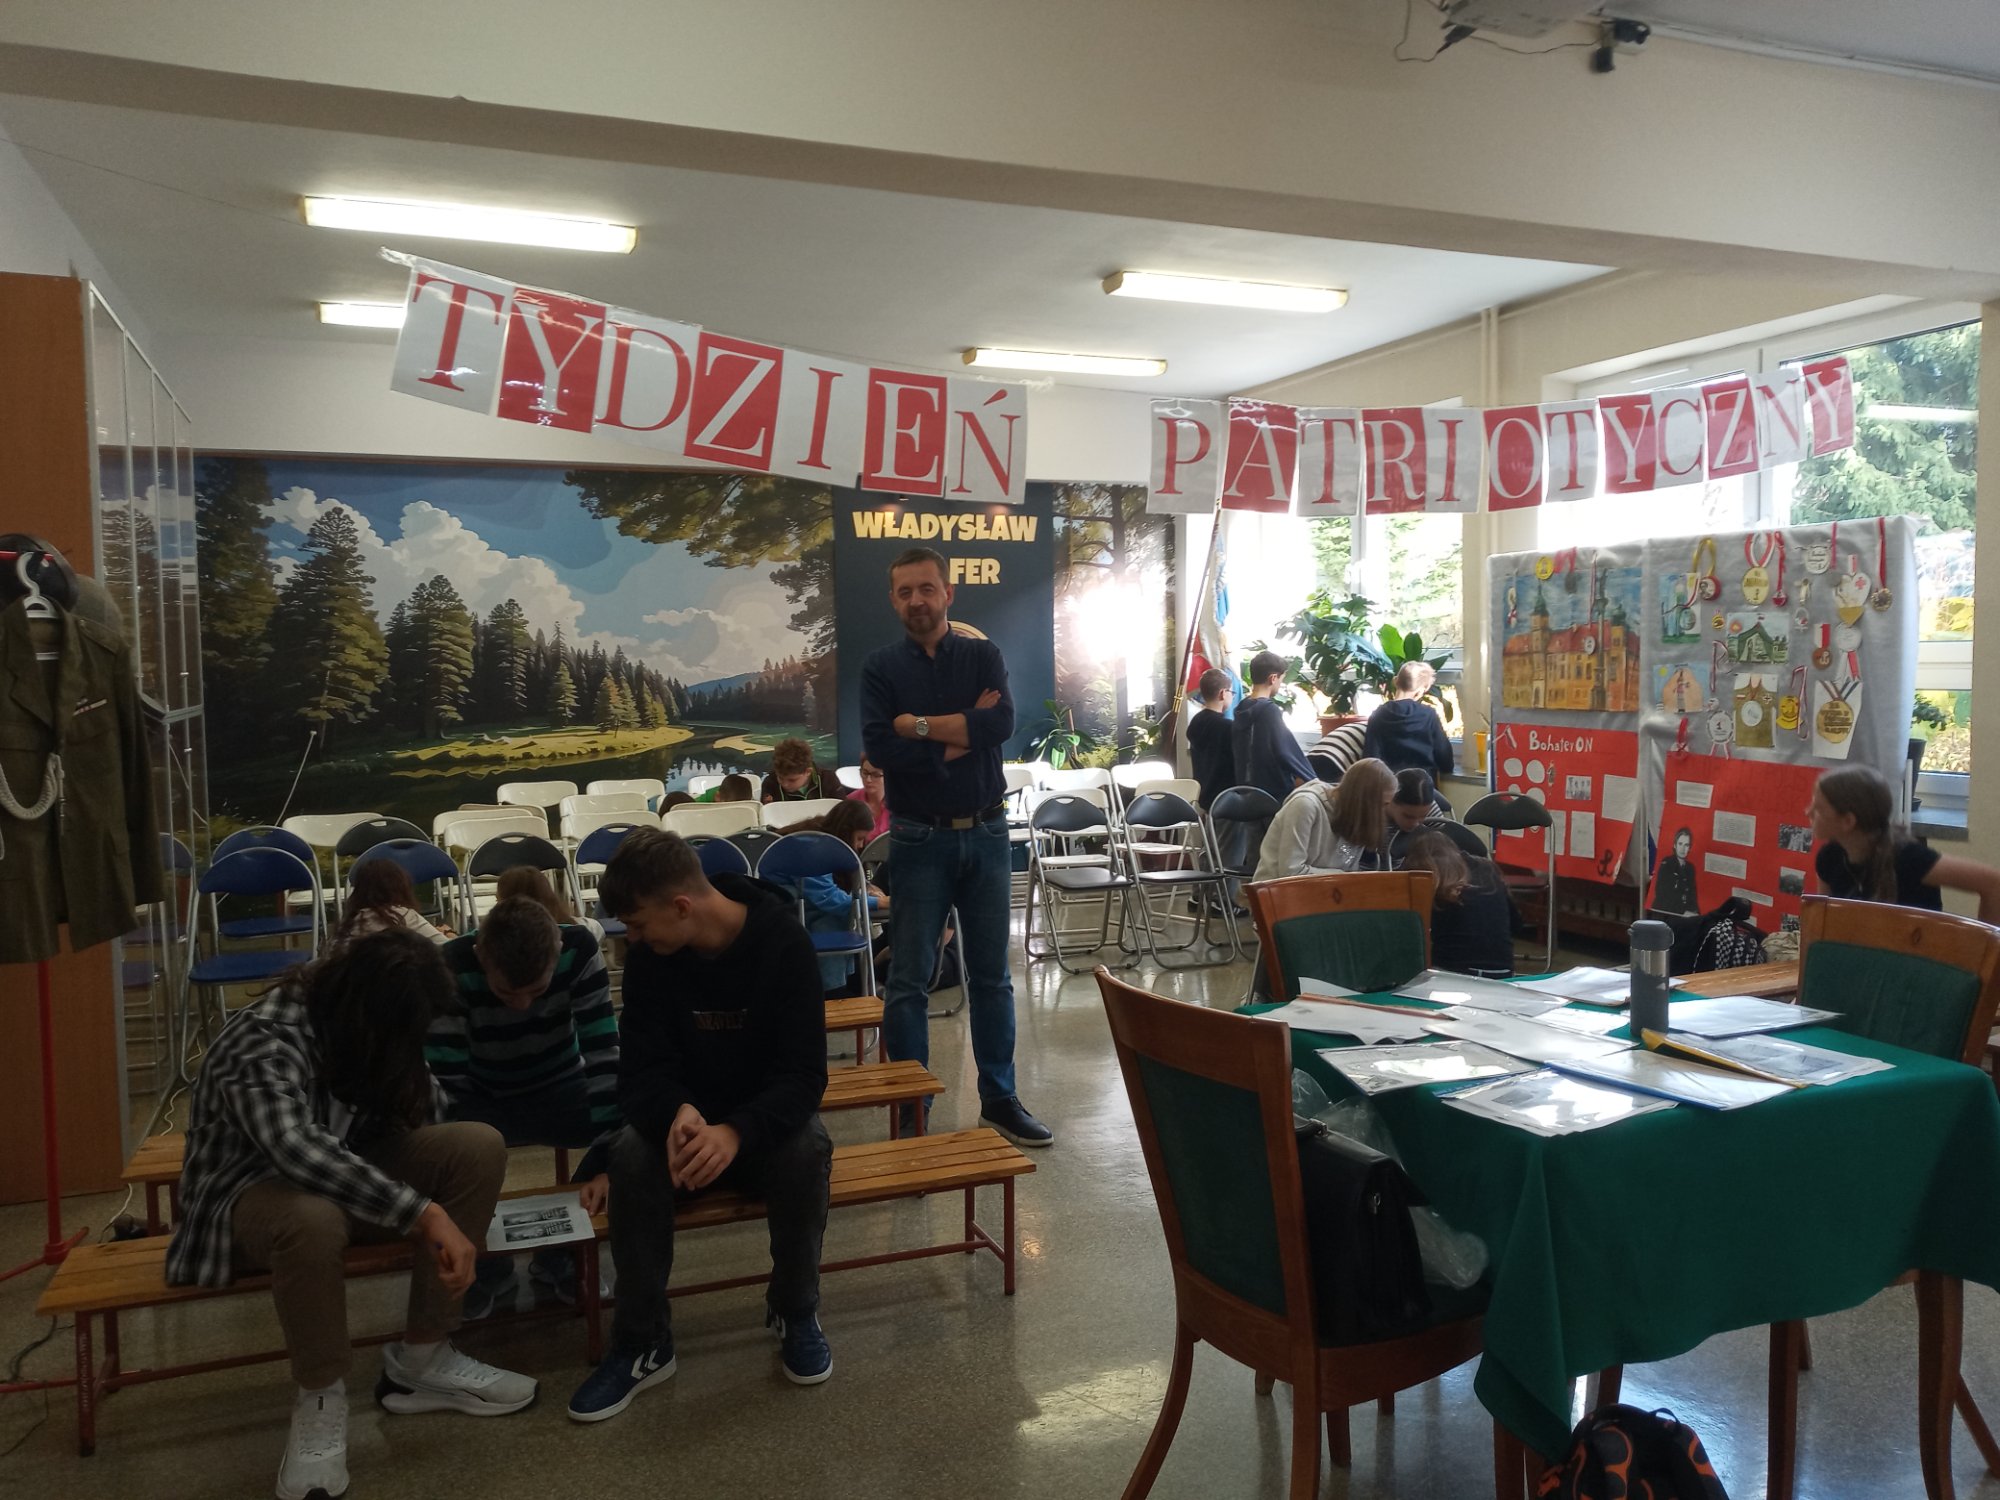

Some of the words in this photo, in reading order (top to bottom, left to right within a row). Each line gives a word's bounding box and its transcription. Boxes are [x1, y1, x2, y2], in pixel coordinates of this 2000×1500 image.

[412, 272, 1020, 496] TYDZIEŃ
[1155, 366, 1850, 504] PATRIOTYCZNY
[852, 511, 1038, 543] WŁADYSŁAW
[949, 557, 1001, 586] FER
[1529, 730, 1594, 753] BohaterON
